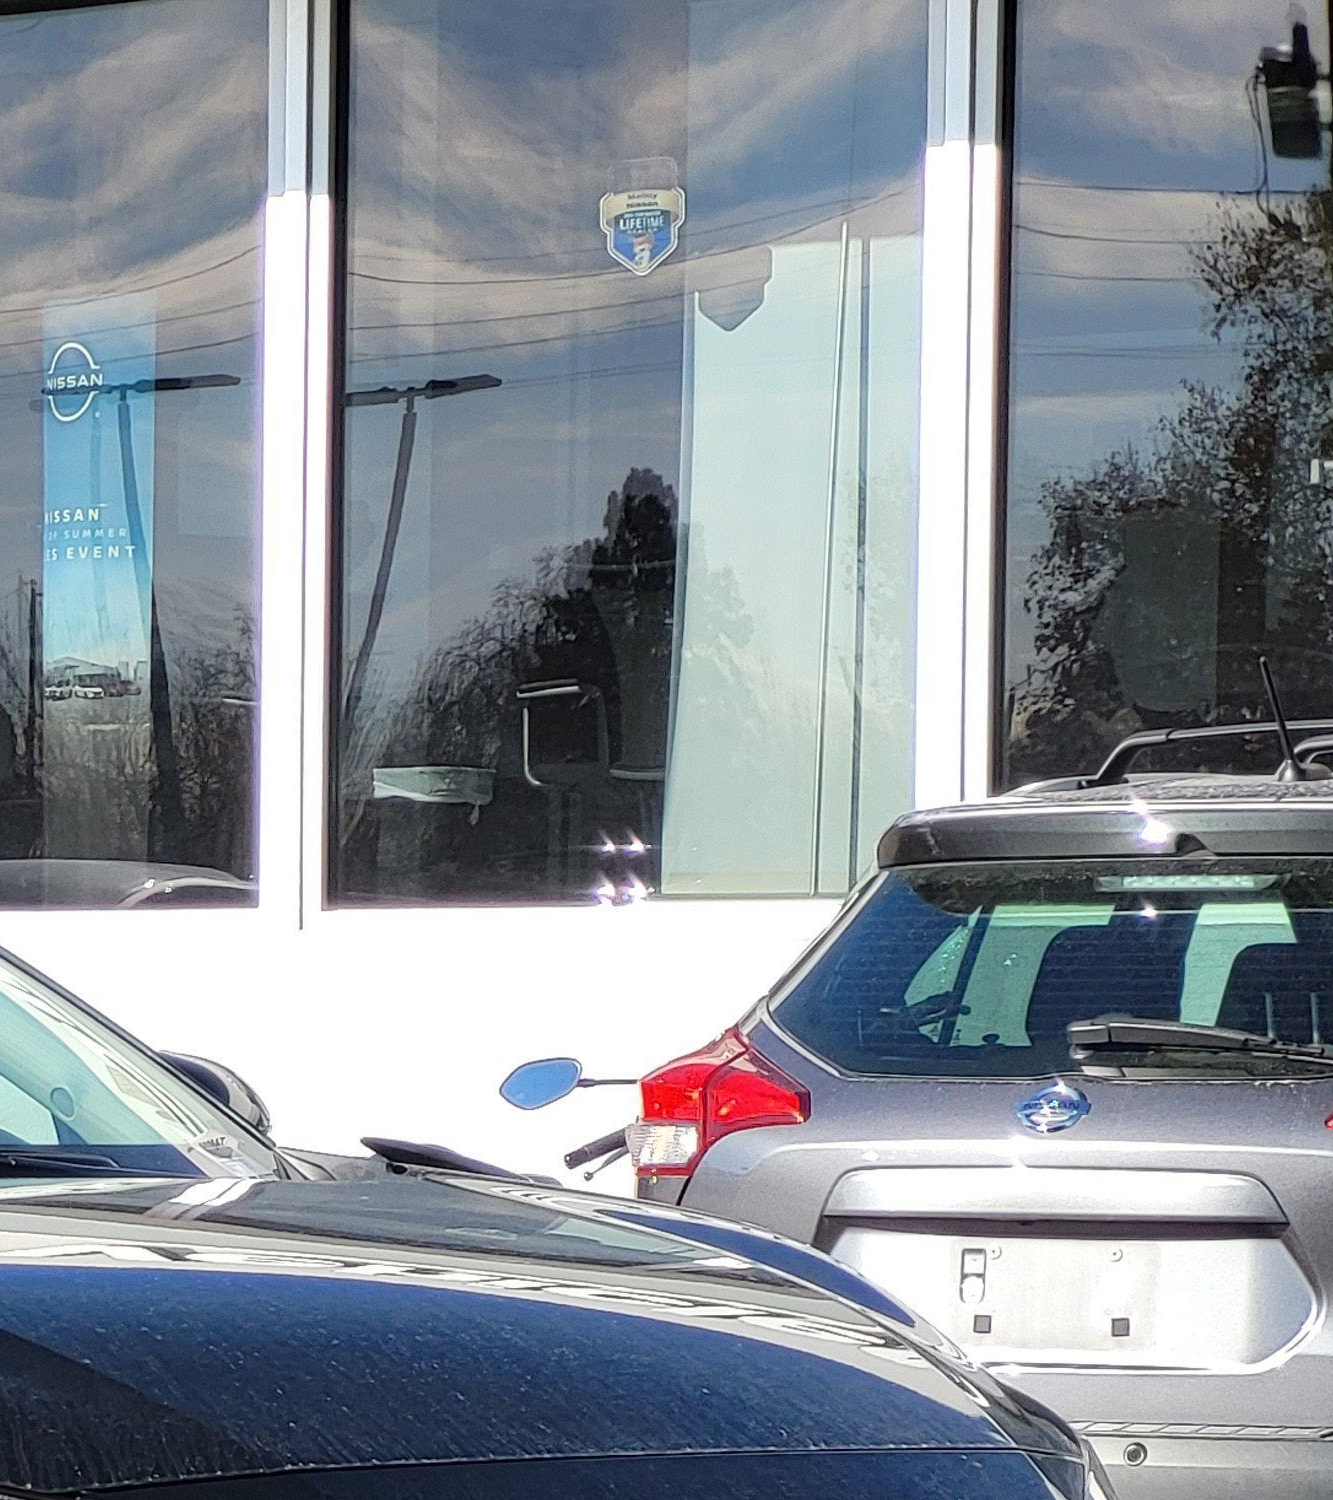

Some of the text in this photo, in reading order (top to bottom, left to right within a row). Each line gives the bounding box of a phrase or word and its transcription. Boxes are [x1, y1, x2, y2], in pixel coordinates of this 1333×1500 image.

[620, 214, 665, 230] LIFETIME
[47, 373, 103, 391] NISSAN
[63, 528, 128, 540] SUMMER
[66, 545, 136, 560] EVENT
